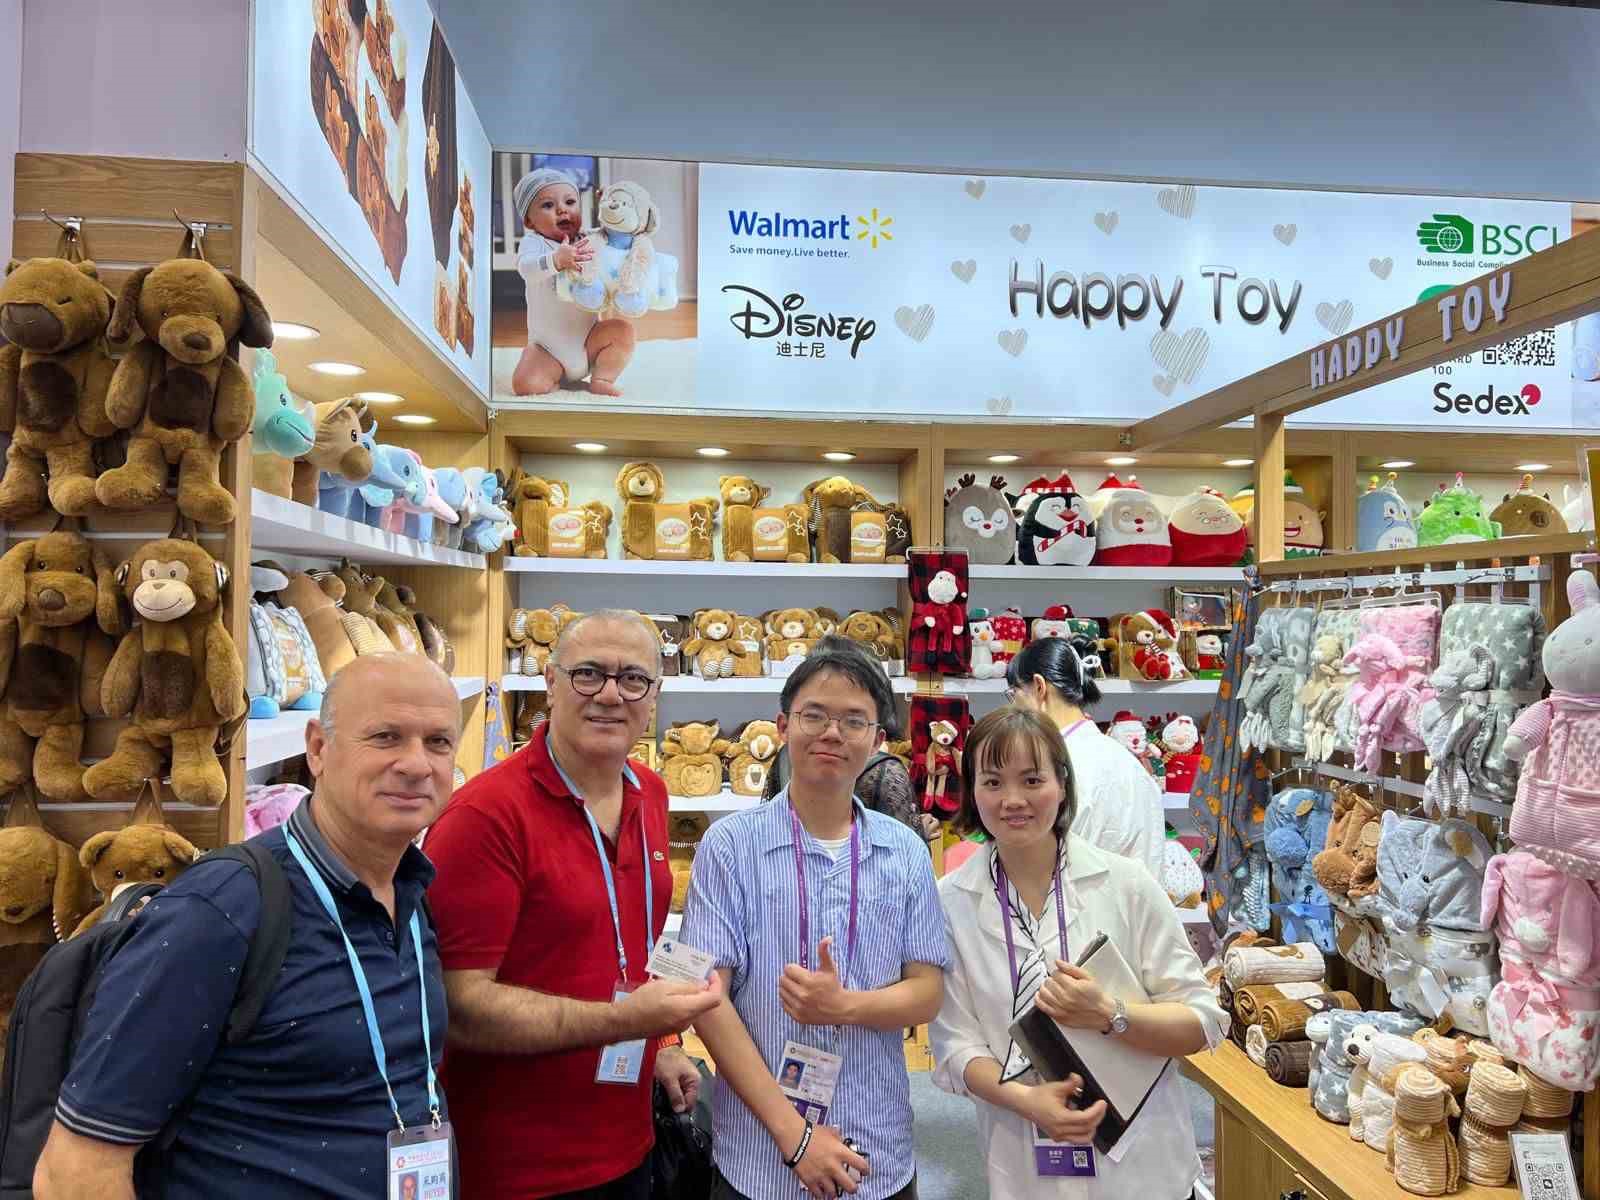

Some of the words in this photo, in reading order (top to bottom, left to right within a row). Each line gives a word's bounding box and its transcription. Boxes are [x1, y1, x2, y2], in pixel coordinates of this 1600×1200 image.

[728, 210, 850, 240] Walmart
[729, 244, 754, 255] Save
[817, 248, 850, 259] better.
[1416, 258, 1449, 268] Business
[1452, 260, 1475, 268] Social
[1008, 256, 1184, 331] Happy
[1200, 264, 1302, 334] Toy
[721, 284, 876, 360] Disney
[1310, 317, 1405, 390] HAPPY
[1438, 271, 1512, 344] TOY
[776, 341, 826, 359] 迪士尼
[1432, 365, 1452, 376] 100
[1433, 382, 1530, 416] Sedex
